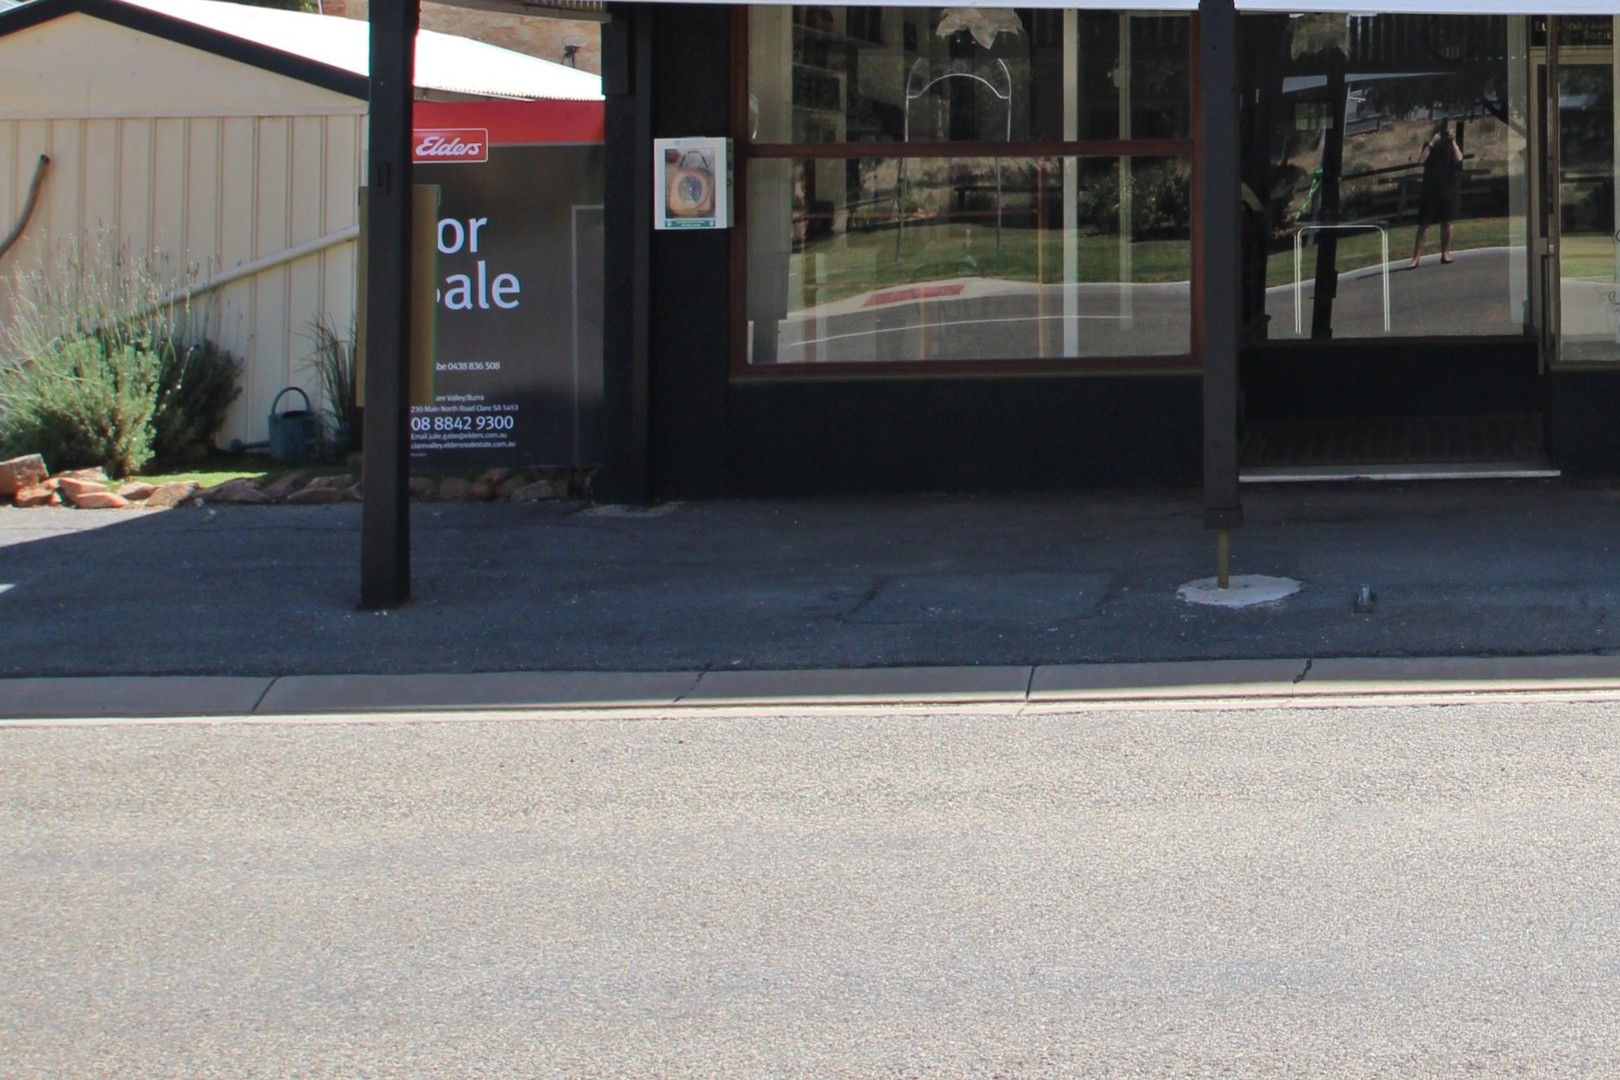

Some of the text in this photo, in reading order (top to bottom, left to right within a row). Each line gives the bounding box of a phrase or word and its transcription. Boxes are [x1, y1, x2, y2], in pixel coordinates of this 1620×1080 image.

[415, 135, 482, 156] Elders
[437, 217, 488, 254] or
[436, 260, 521, 310] ale
[411, 415, 514, 431] 08 8842 9300
